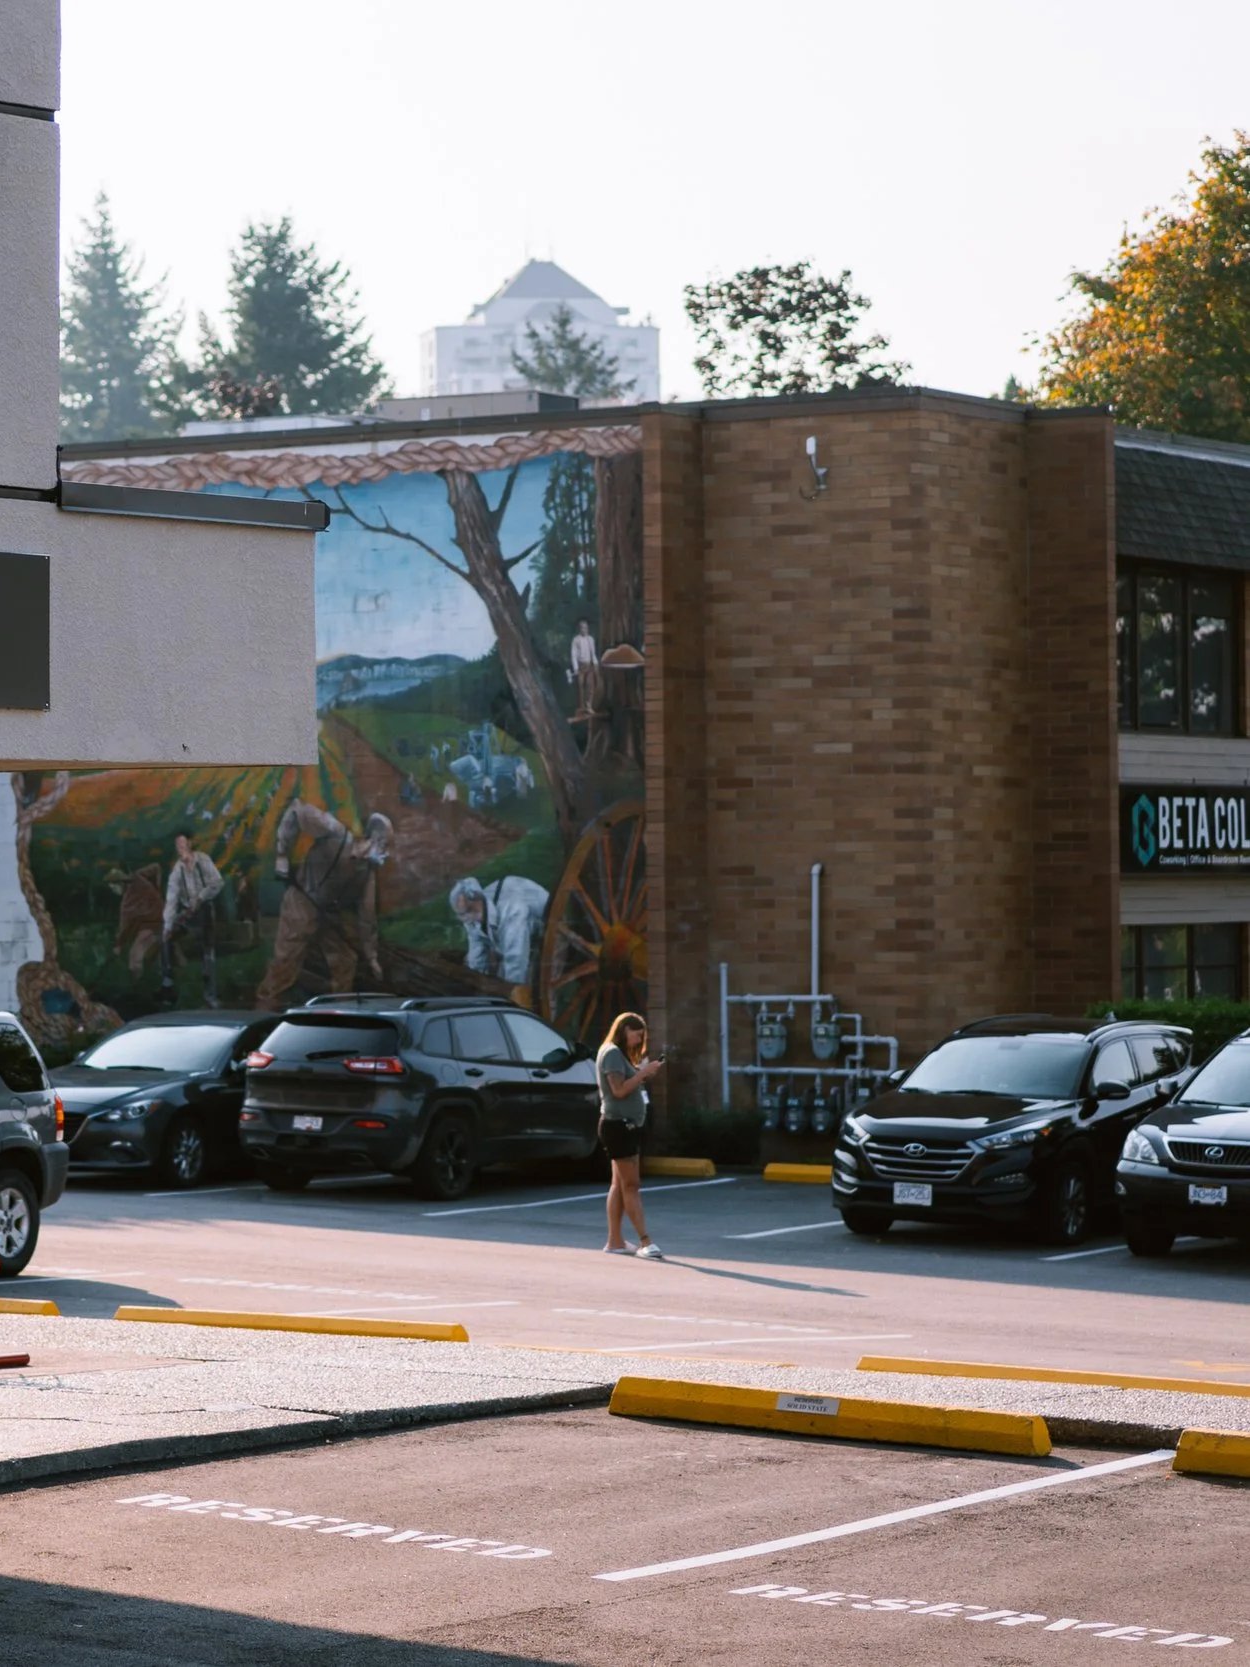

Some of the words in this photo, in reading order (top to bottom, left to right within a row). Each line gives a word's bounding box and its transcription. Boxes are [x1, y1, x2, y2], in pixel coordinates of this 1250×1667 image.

[1158, 796, 1210, 849] BETA
[1214, 797, 1250, 850] COL
[114, 1493, 553, 1560] RESERVED
[728, 1583, 1235, 1649] RESERVED
